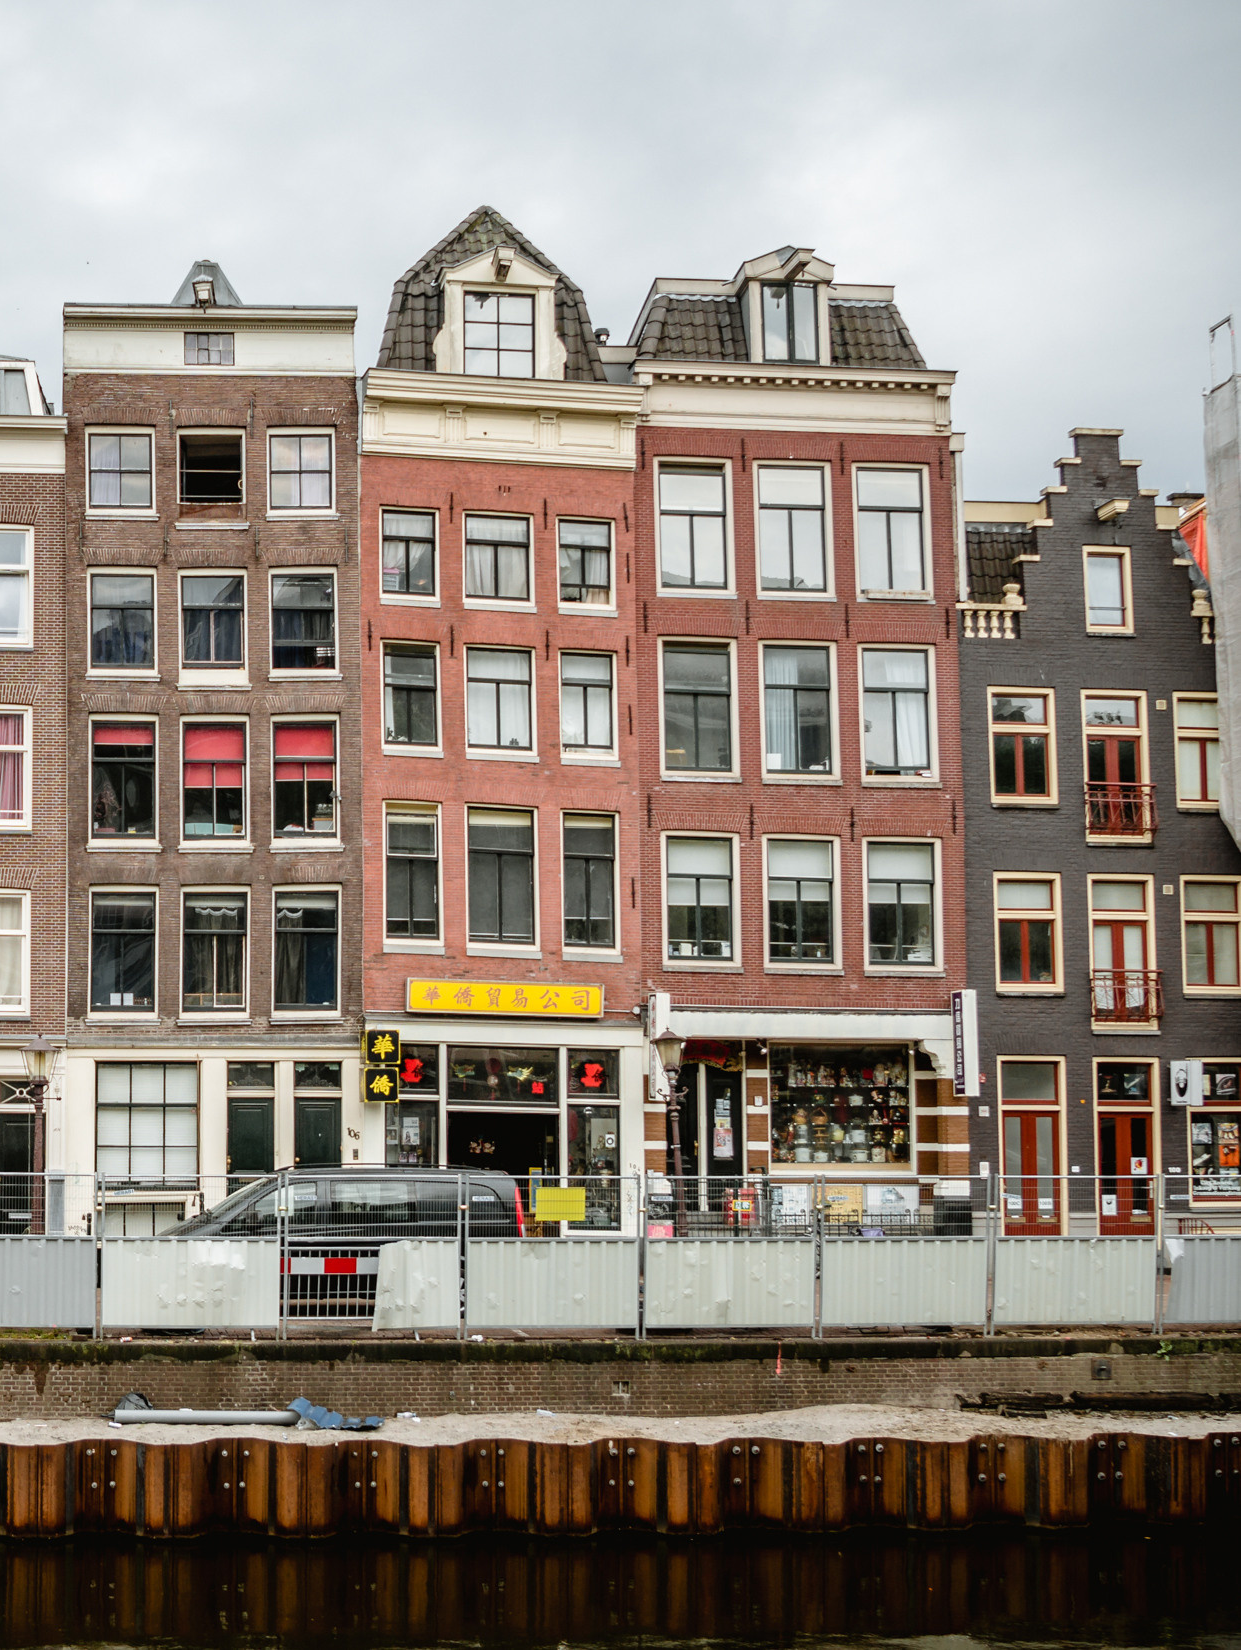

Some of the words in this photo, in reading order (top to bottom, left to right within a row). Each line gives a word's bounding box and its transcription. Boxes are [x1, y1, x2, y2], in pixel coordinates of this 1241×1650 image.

[422, 985, 590, 1010] 華僑貿易公司
[371, 1033, 395, 1060] 華
[369, 1074, 394, 1096] 僑
[347, 1127, 360, 1140] 106
